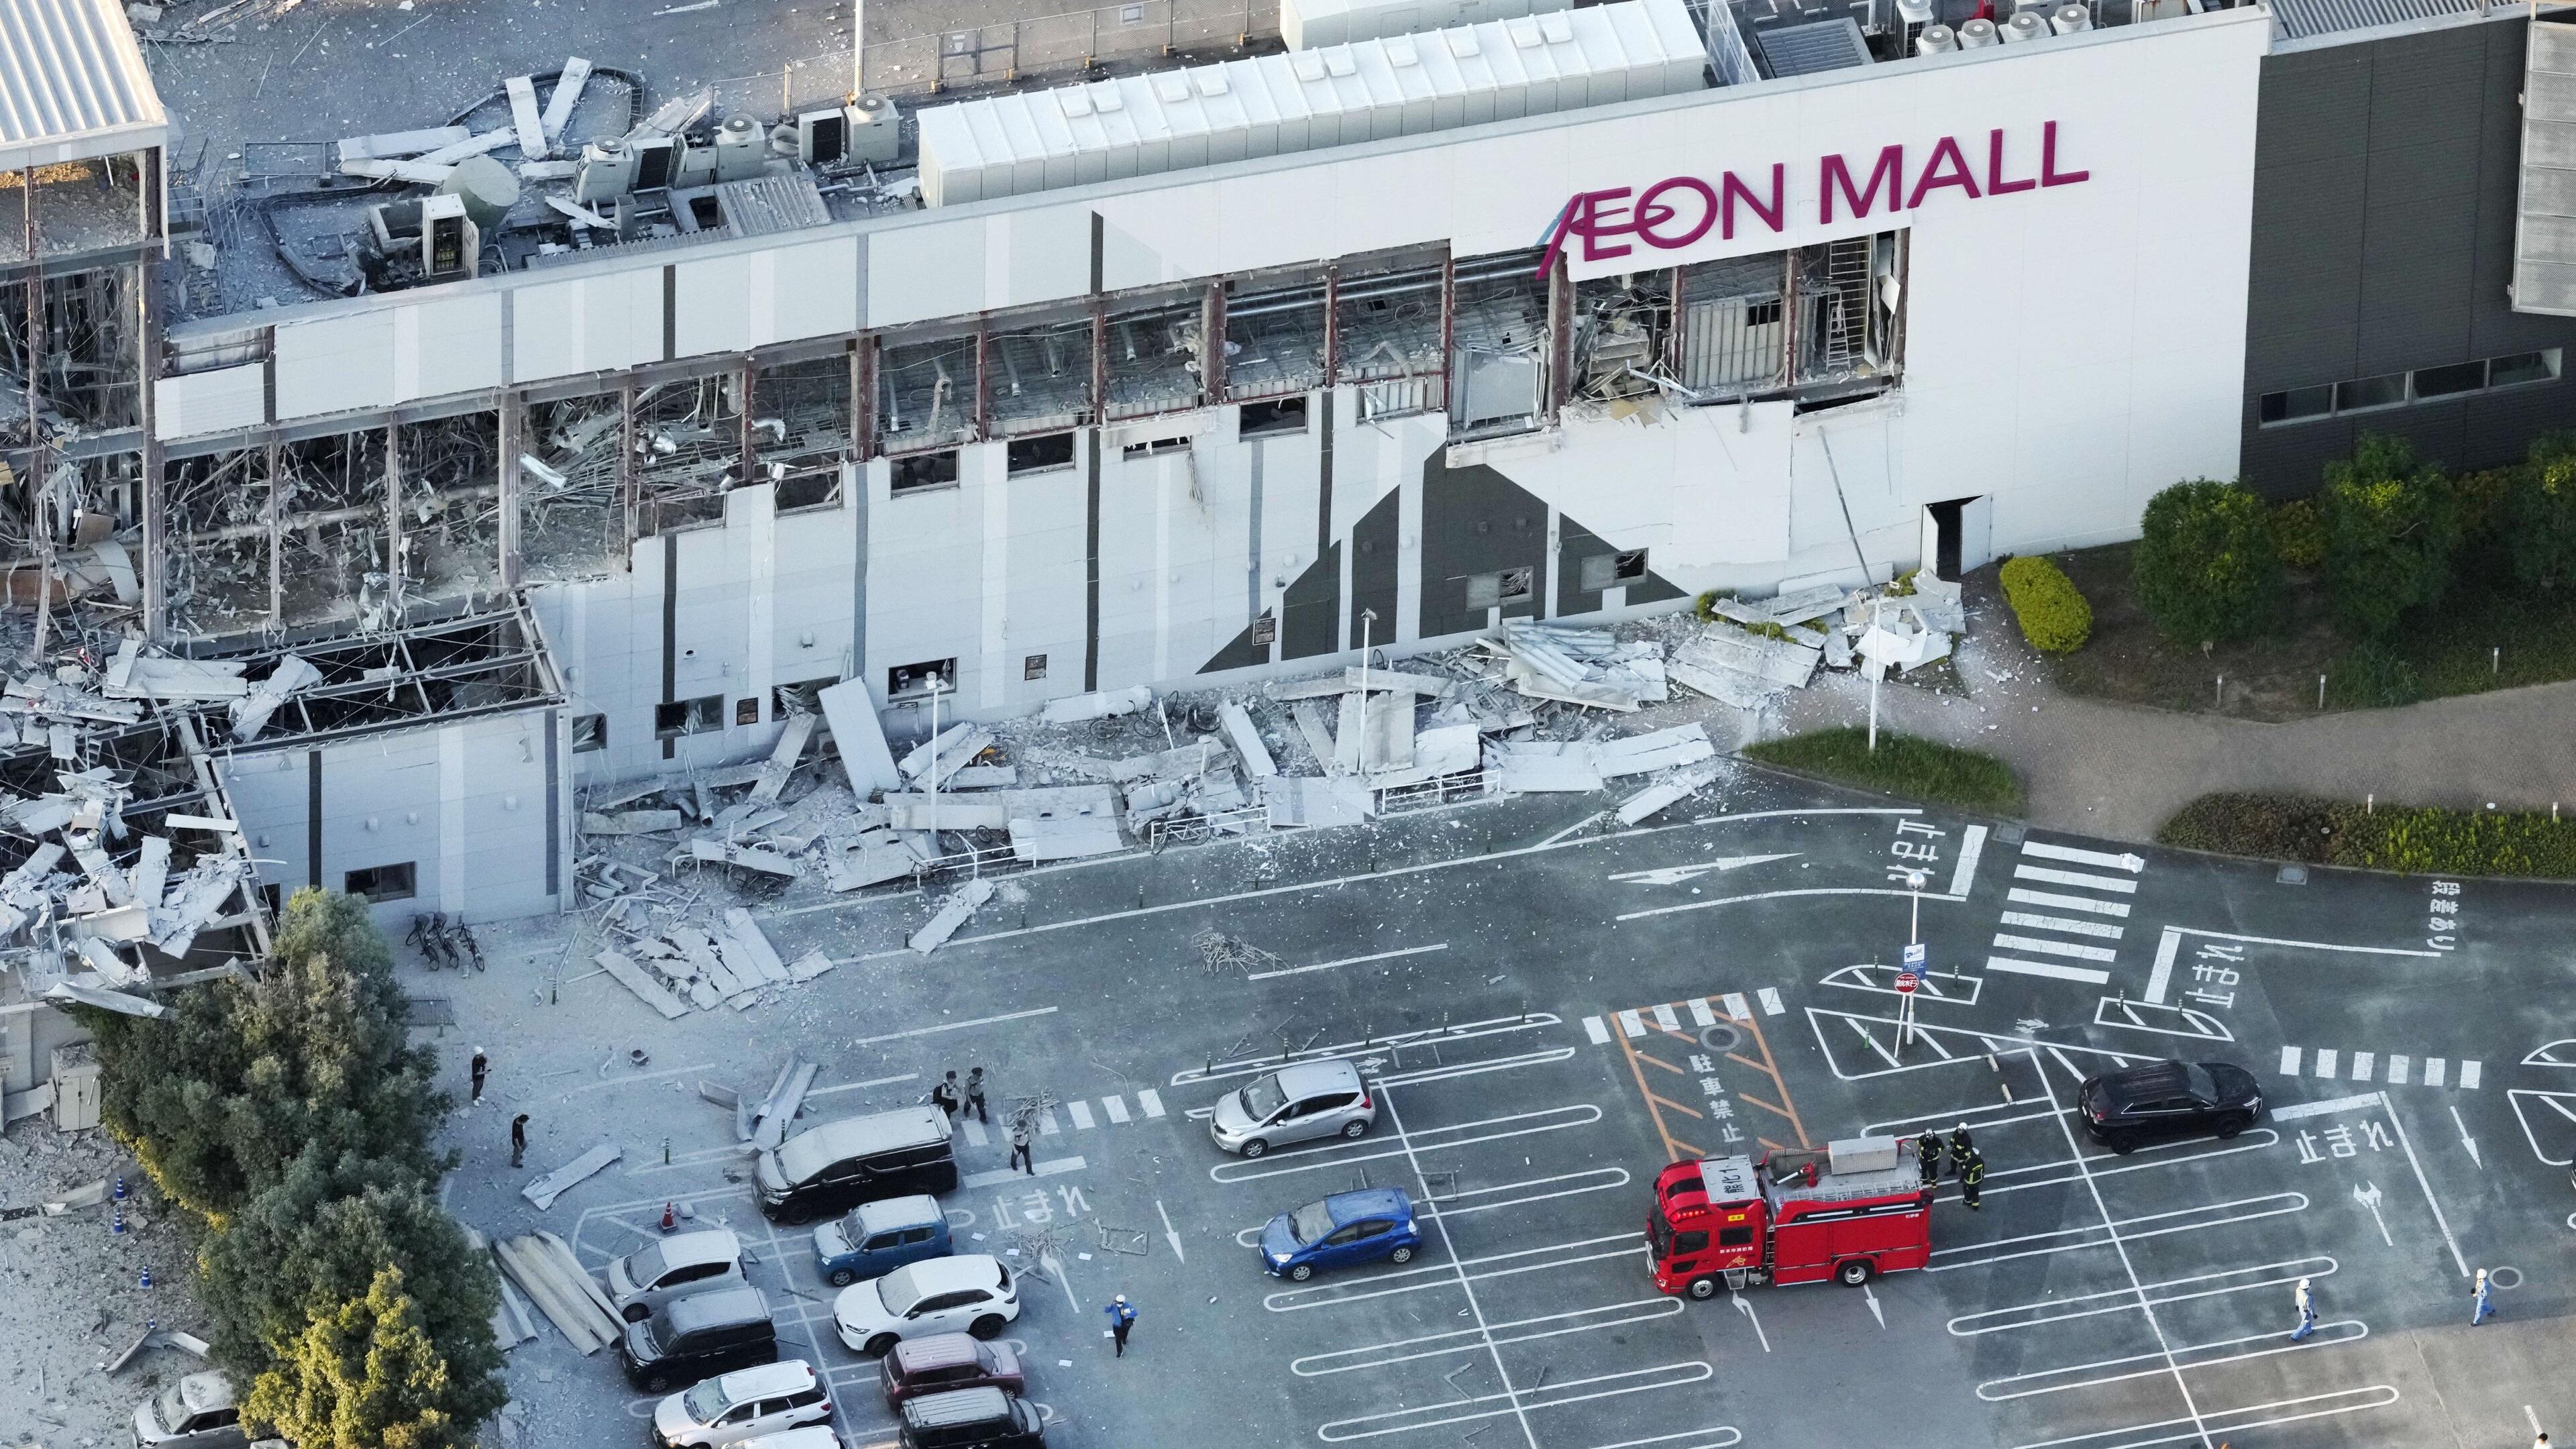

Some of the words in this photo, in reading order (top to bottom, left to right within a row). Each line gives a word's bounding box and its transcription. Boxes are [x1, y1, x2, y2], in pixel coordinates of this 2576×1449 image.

[1821, 120, 2090, 225] MALL
[1886, 818, 1945, 881] 止まれ
[2426, 880, 2461, 950] 段差あり
[2185, 943, 2245, 1008] 止まれ
[1688, 1053, 1745, 1143] 駐車禁止
[2295, 1119, 2394, 1165] 止まれ
[992, 1185, 1092, 1230] 止まれ
